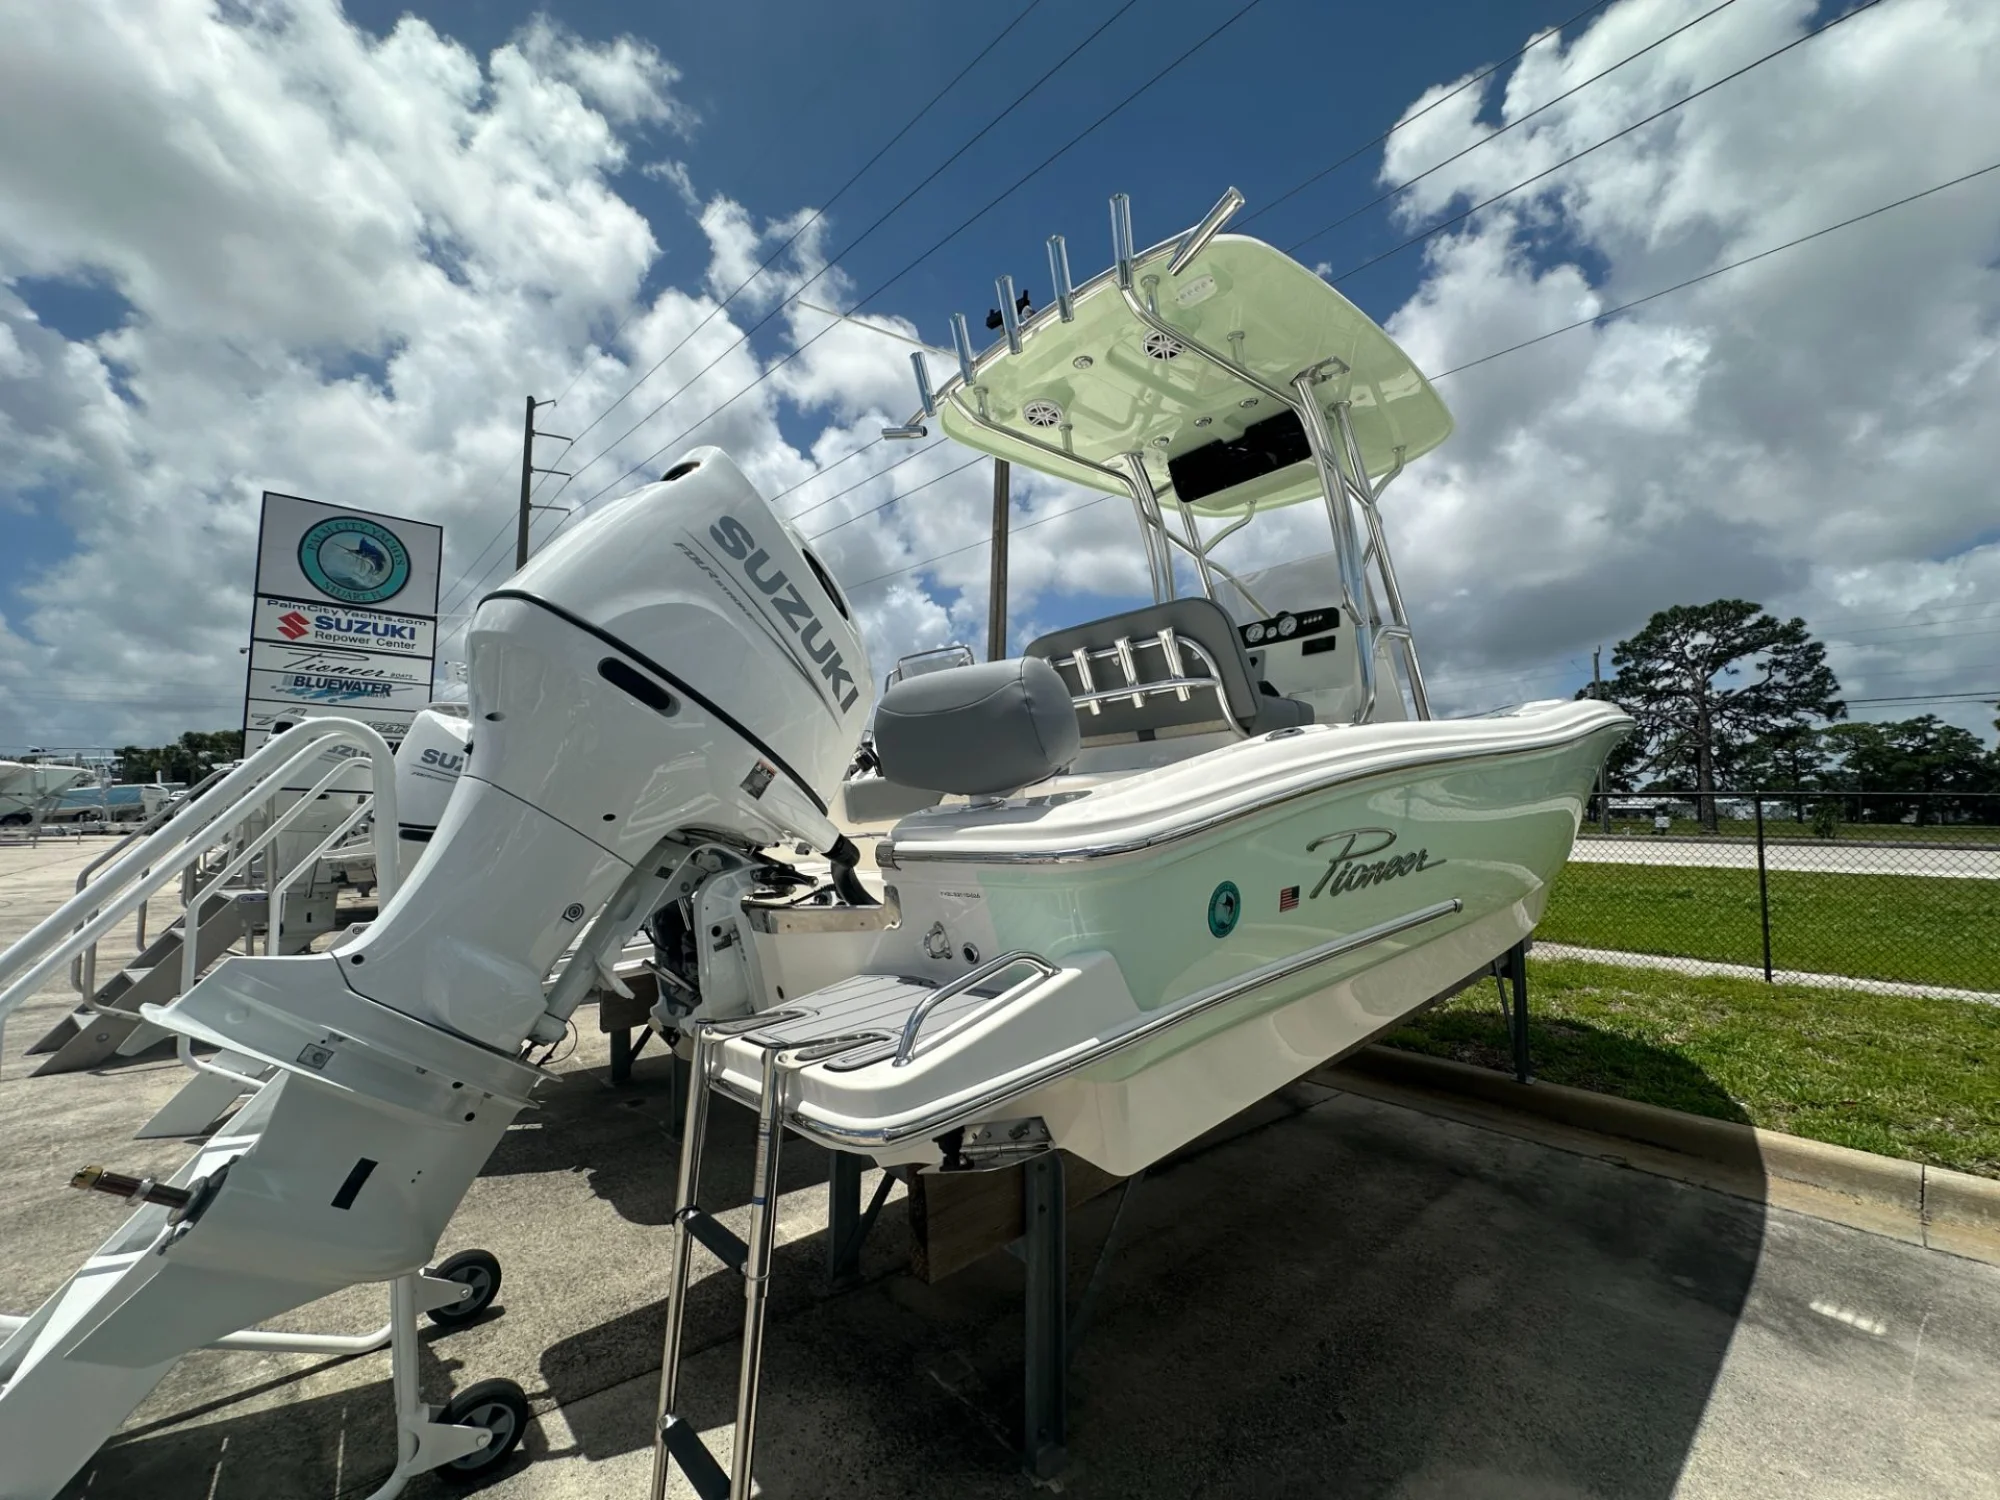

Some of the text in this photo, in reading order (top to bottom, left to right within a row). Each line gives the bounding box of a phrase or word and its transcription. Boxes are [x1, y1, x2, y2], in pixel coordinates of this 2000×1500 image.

[307, 526, 331, 551] PALM
[335, 522, 369, 533] CITY
[324, 581, 386, 601] STUART FL
[314, 615, 416, 640] SUZUKI
[710, 515, 859, 714] SUZUKI
[315, 631, 417, 650] Repower Center
[269, 645, 390, 677] Pioneer
[293, 675, 393, 698] BLUEWATER
[1306, 826, 1447, 899] Pioneer
